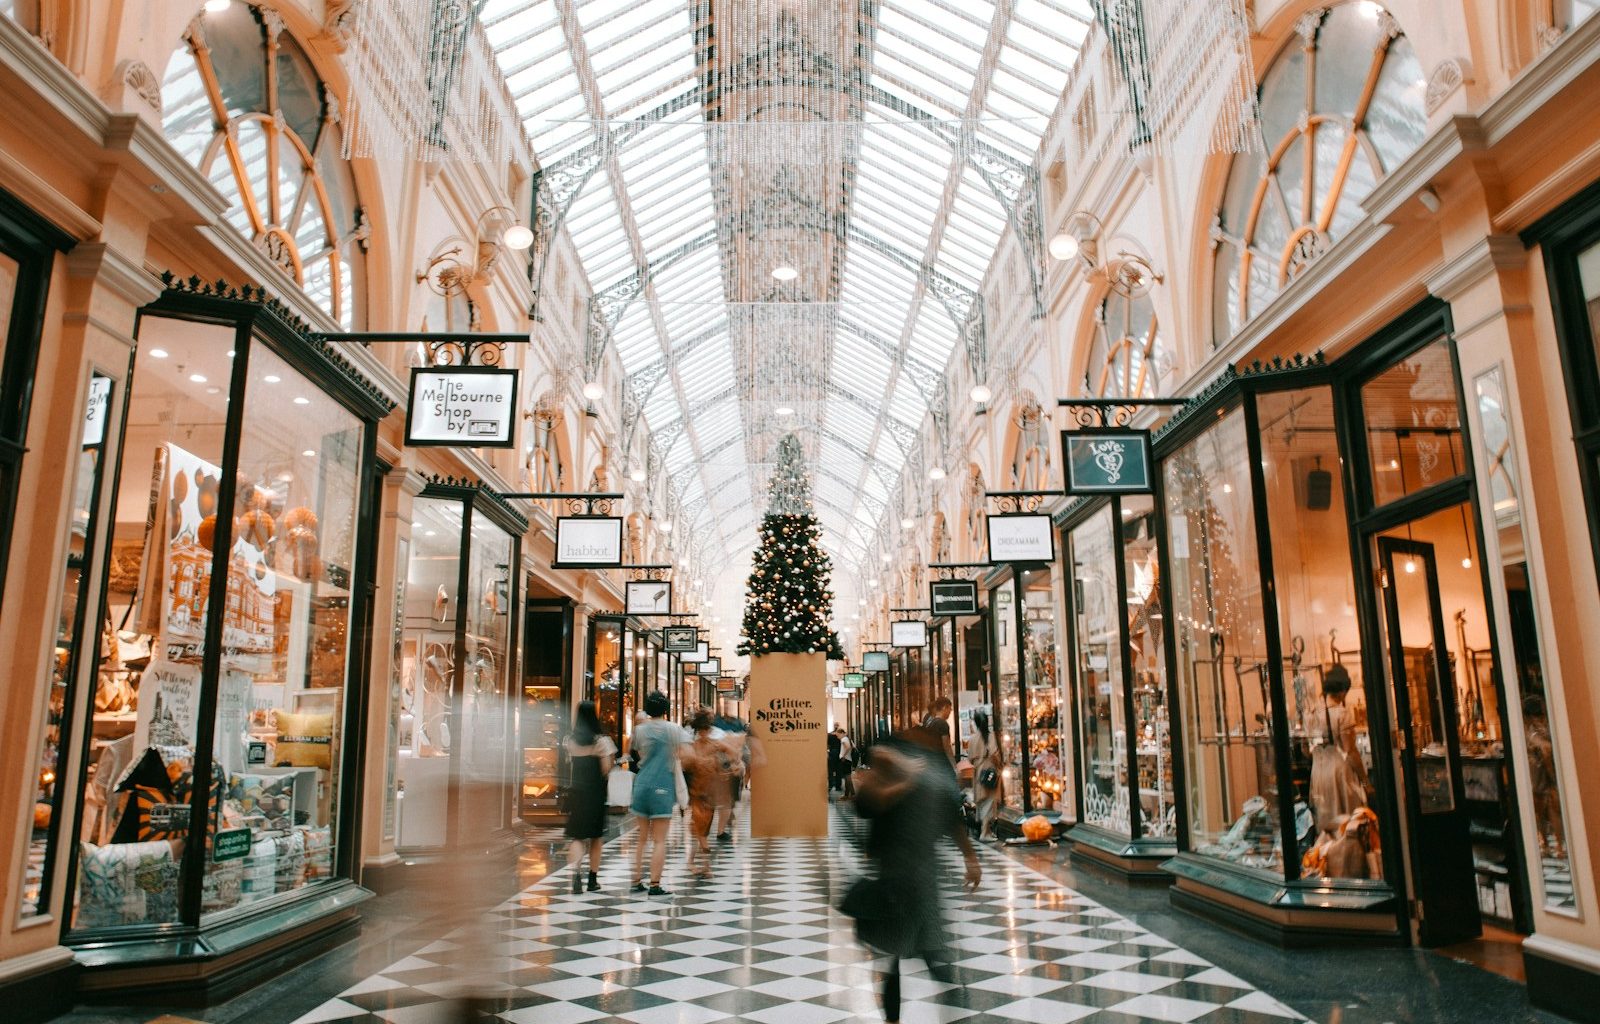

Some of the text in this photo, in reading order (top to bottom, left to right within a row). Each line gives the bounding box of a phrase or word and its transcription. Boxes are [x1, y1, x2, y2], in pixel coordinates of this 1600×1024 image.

[438, 378, 463, 392] The
[421, 387, 503, 403] Melbourne
[434, 404, 472, 420] Shop
[447, 418, 465, 433] by
[769, 698, 812, 710] Glitter.
